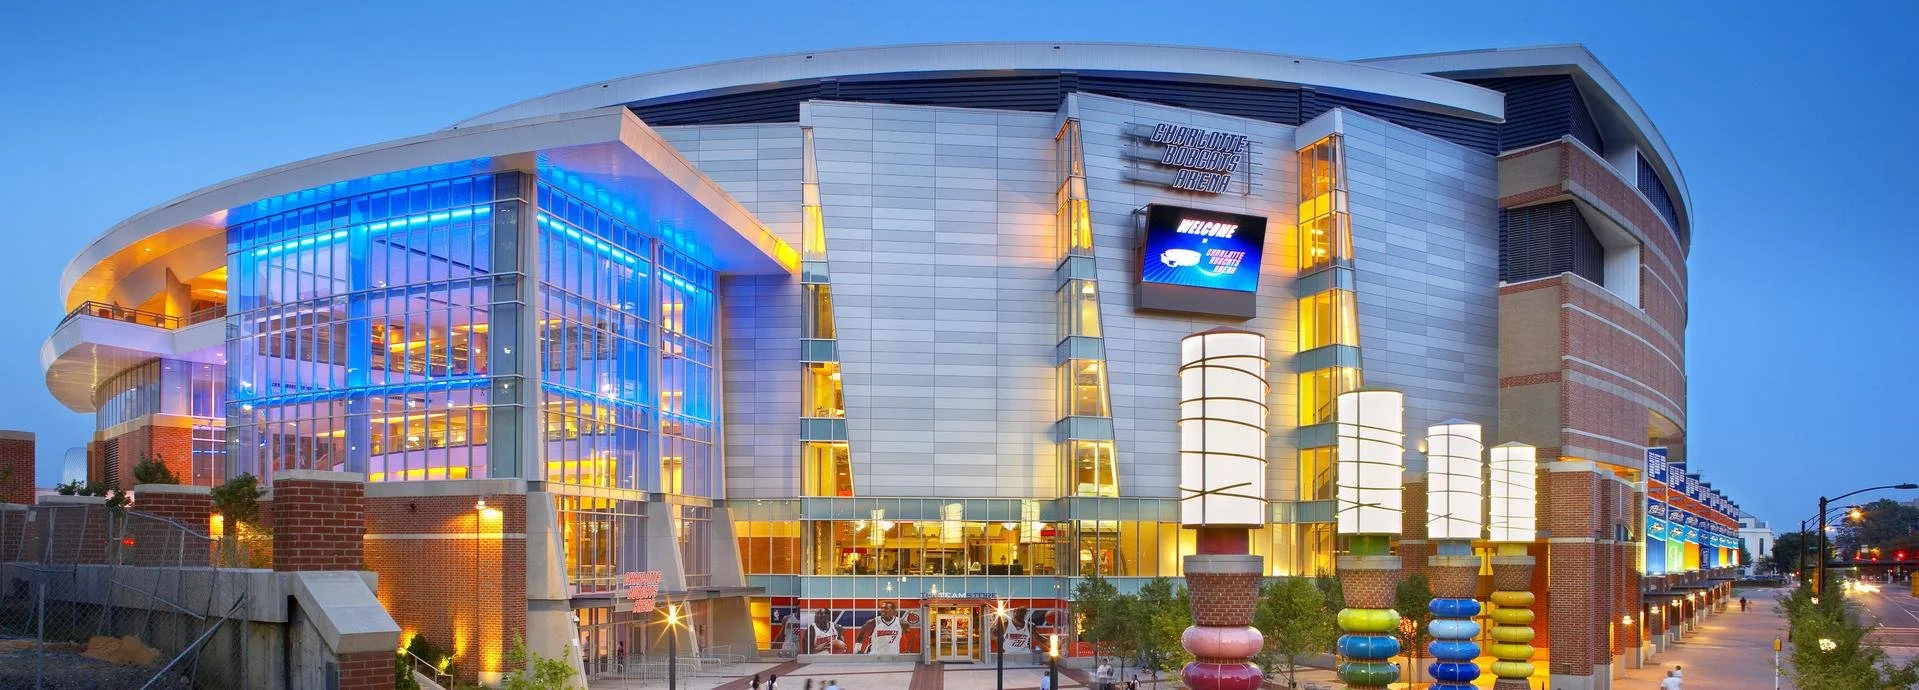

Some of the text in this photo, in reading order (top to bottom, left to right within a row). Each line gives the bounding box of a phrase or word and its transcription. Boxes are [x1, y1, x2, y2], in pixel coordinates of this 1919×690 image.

[1151, 123, 1248, 153] CHARLOTTE
[1161, 144, 1241, 173] BOBCATS
[1173, 168, 1231, 194] ARENA
[1176, 218, 1239, 239] WELCOME
